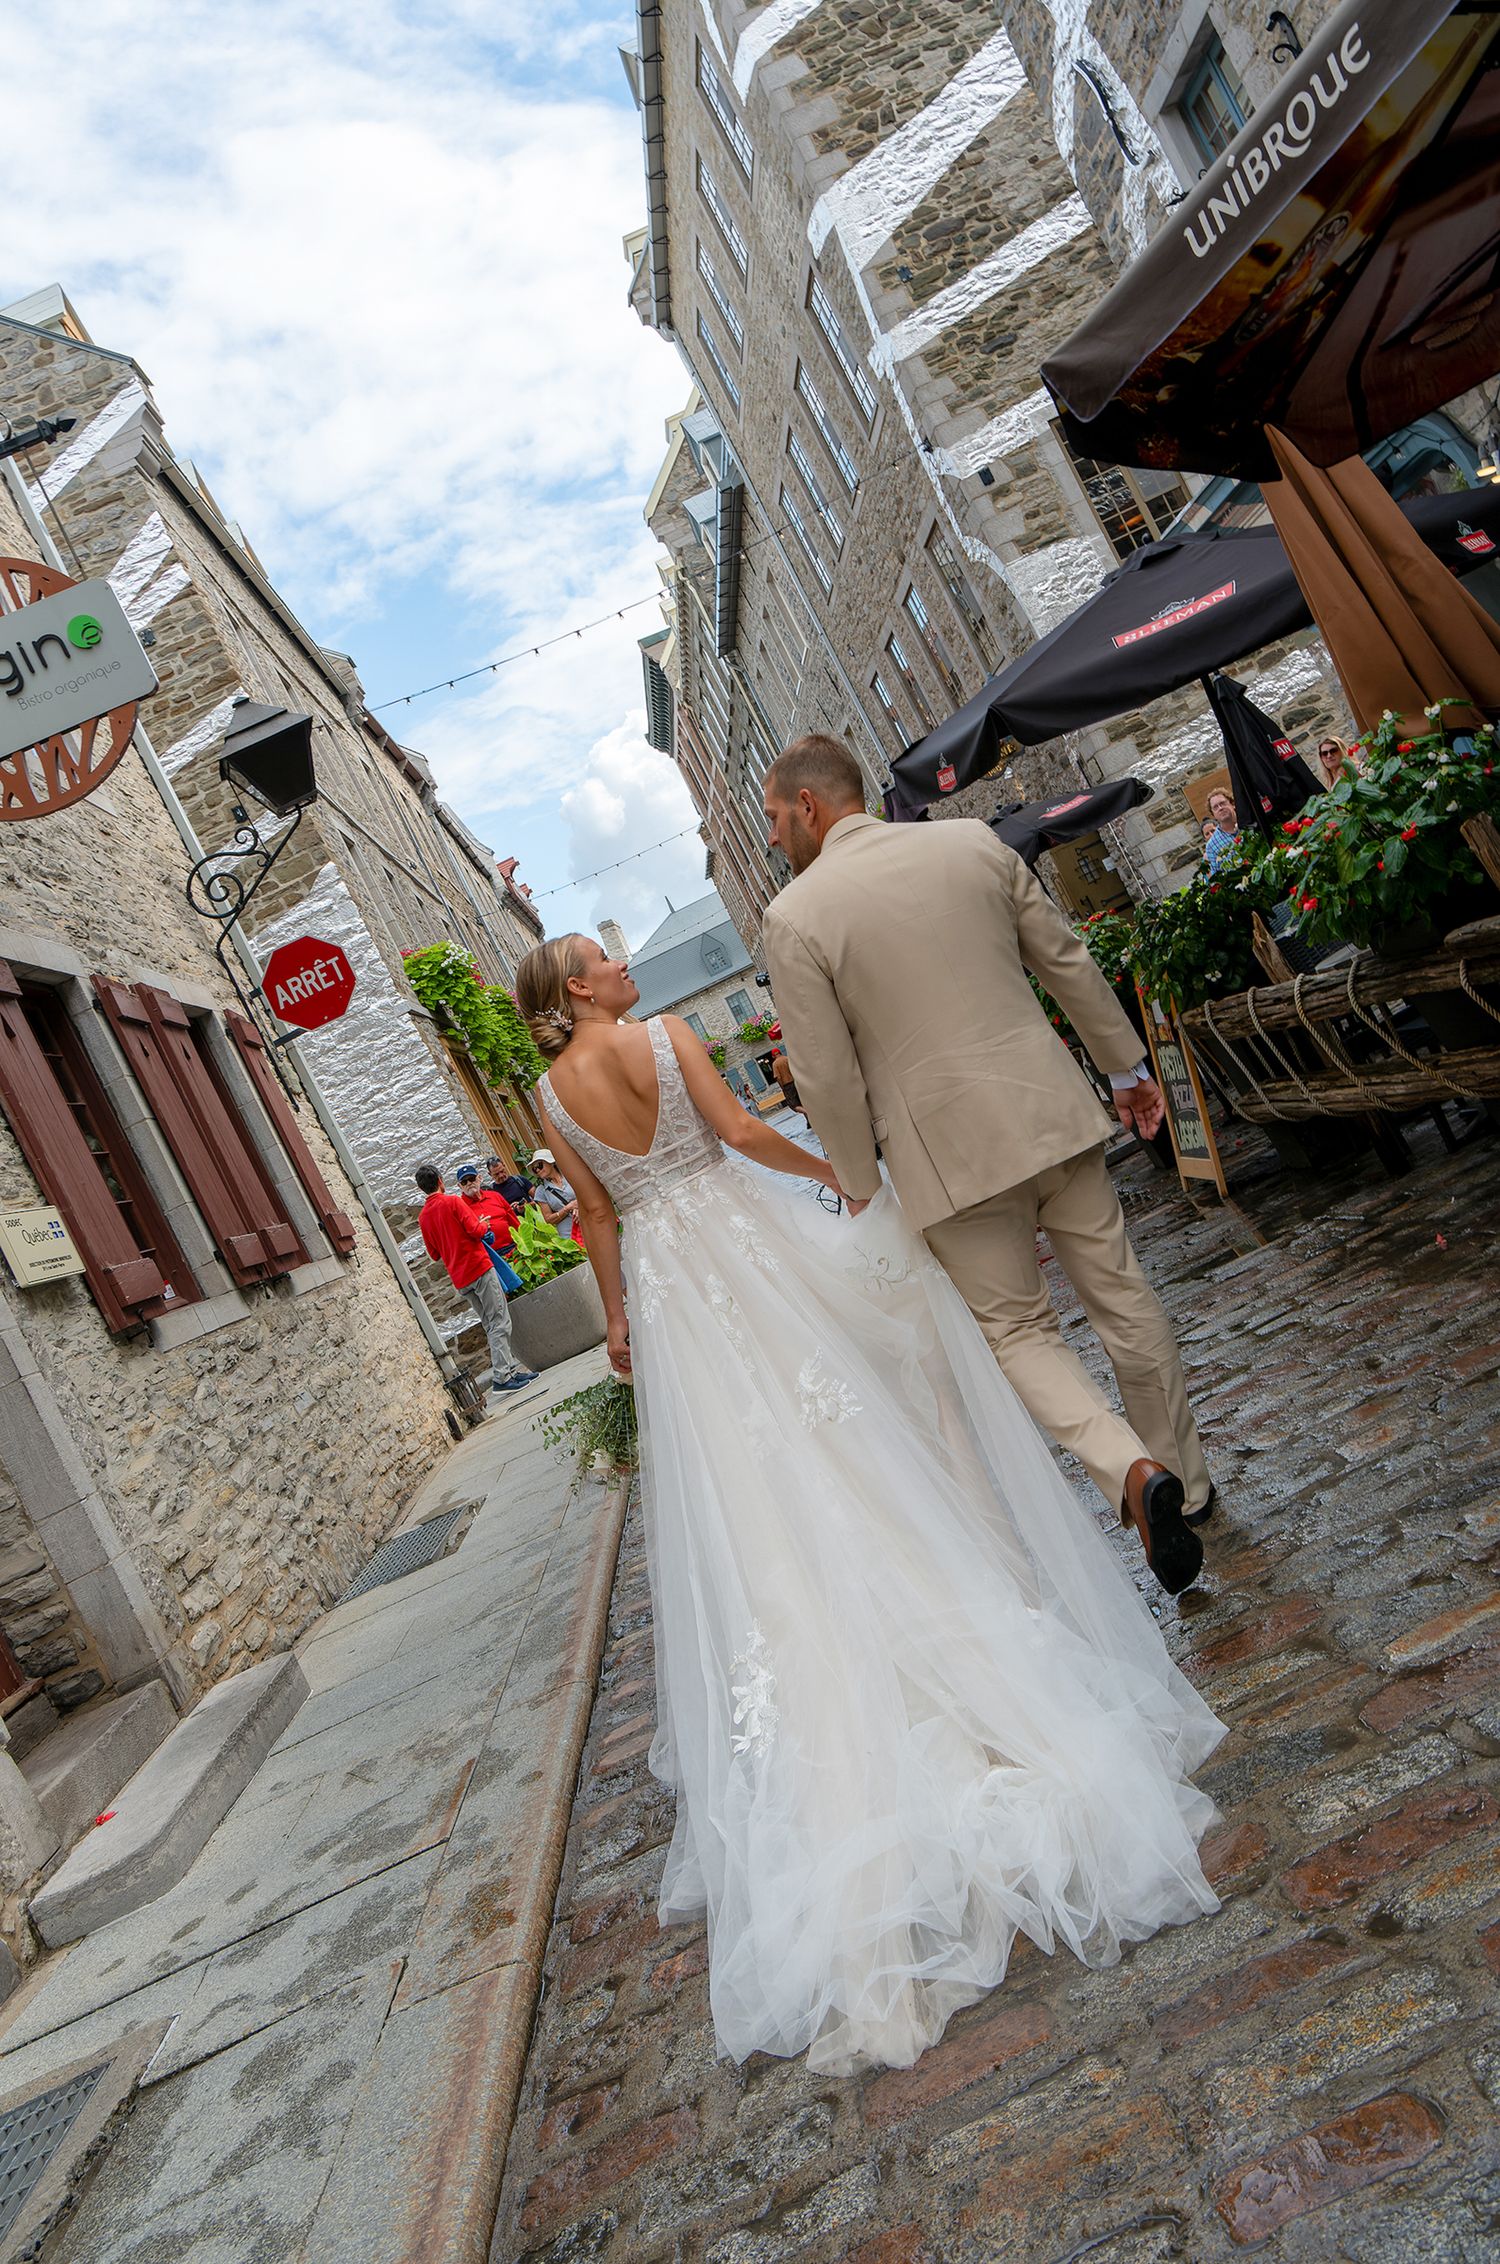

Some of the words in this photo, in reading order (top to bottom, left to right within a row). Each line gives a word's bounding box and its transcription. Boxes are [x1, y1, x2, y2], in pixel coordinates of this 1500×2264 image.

[1183, 22, 1371, 258] UNIBROUE
[1123, 590, 1227, 643] SLEEMAN
[17, 690, 53, 711] Bistro
[55, 660, 121, 694] organique
[275, 956, 344, 1010] ARRÊT
[1157, 1045, 1187, 1082] PASTA
[22, 1227, 53, 1246] Québec
